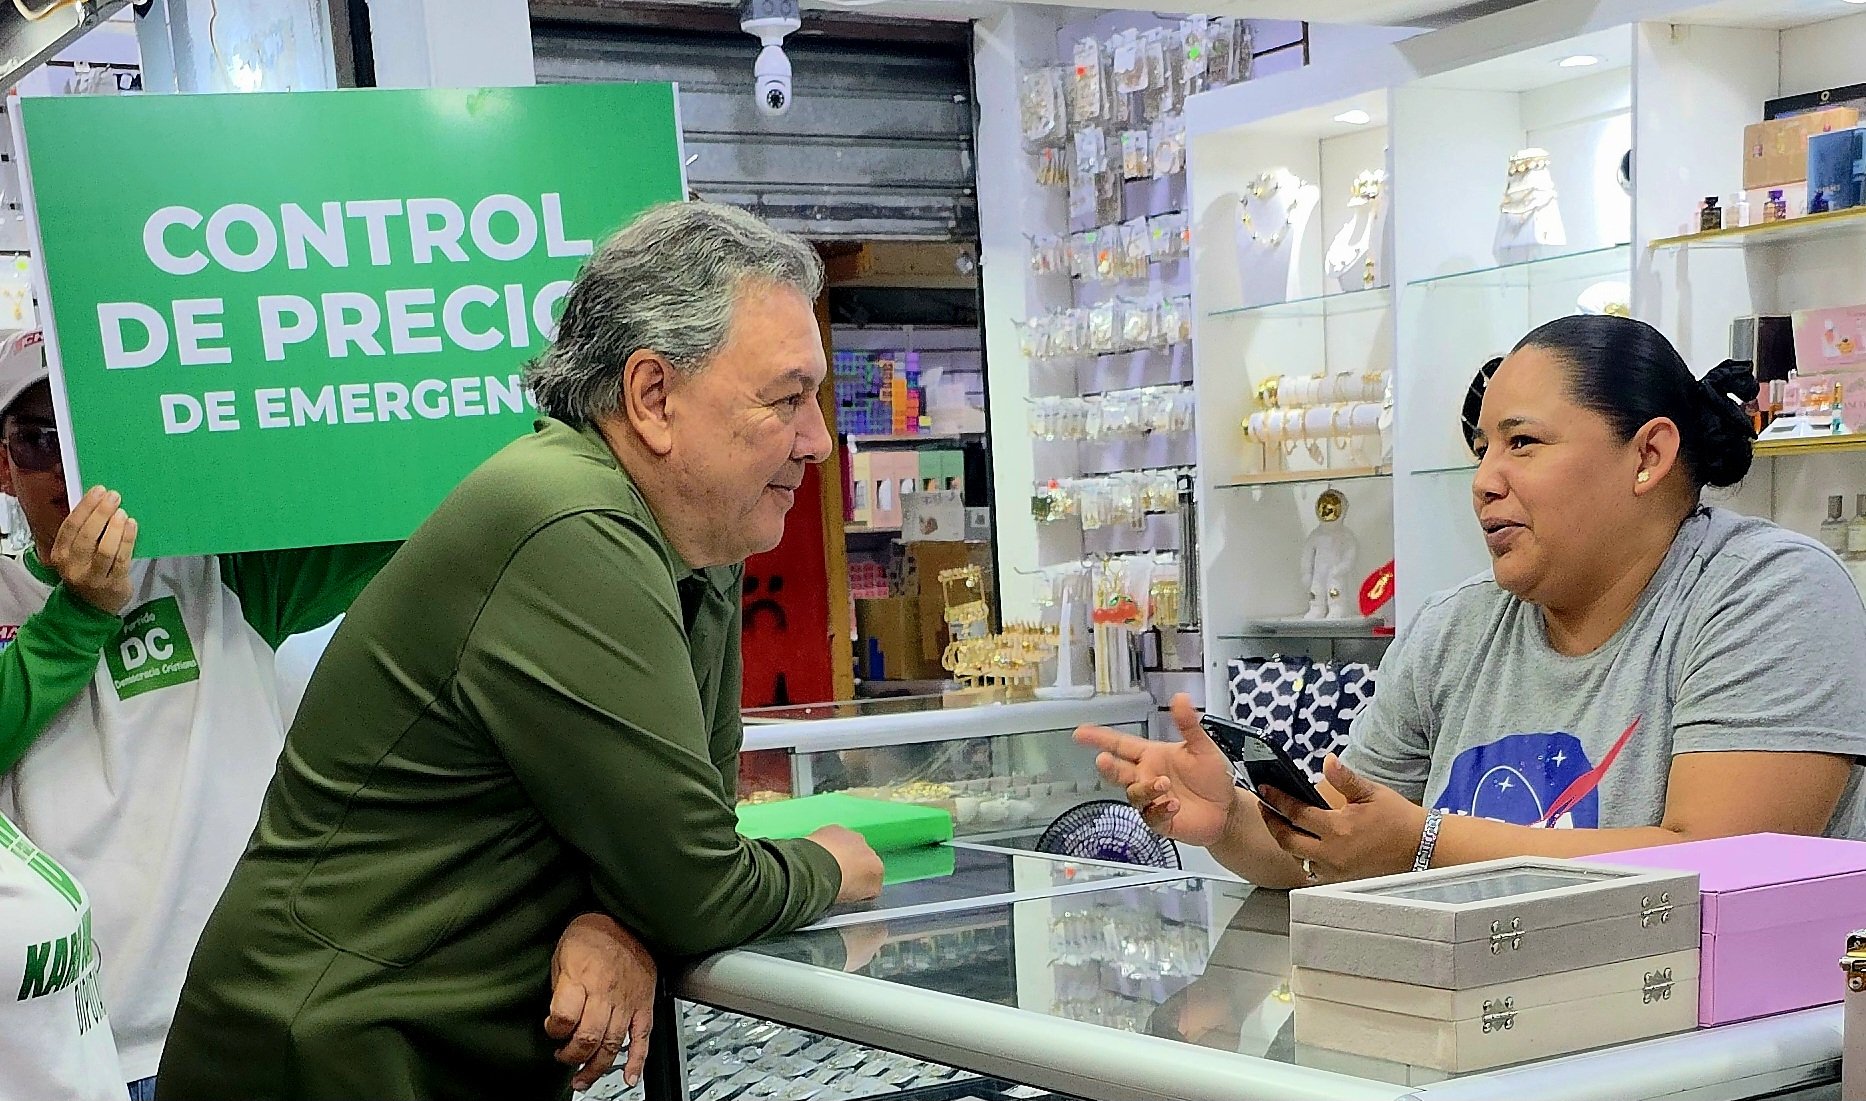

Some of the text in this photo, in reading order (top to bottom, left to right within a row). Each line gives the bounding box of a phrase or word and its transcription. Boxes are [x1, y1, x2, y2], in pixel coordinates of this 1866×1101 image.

[143, 192, 594, 274] CONTROL
[97, 298, 232, 369] DE
[160, 374, 538, 434] DE EMERGEN
[120, 627, 174, 671] DC
